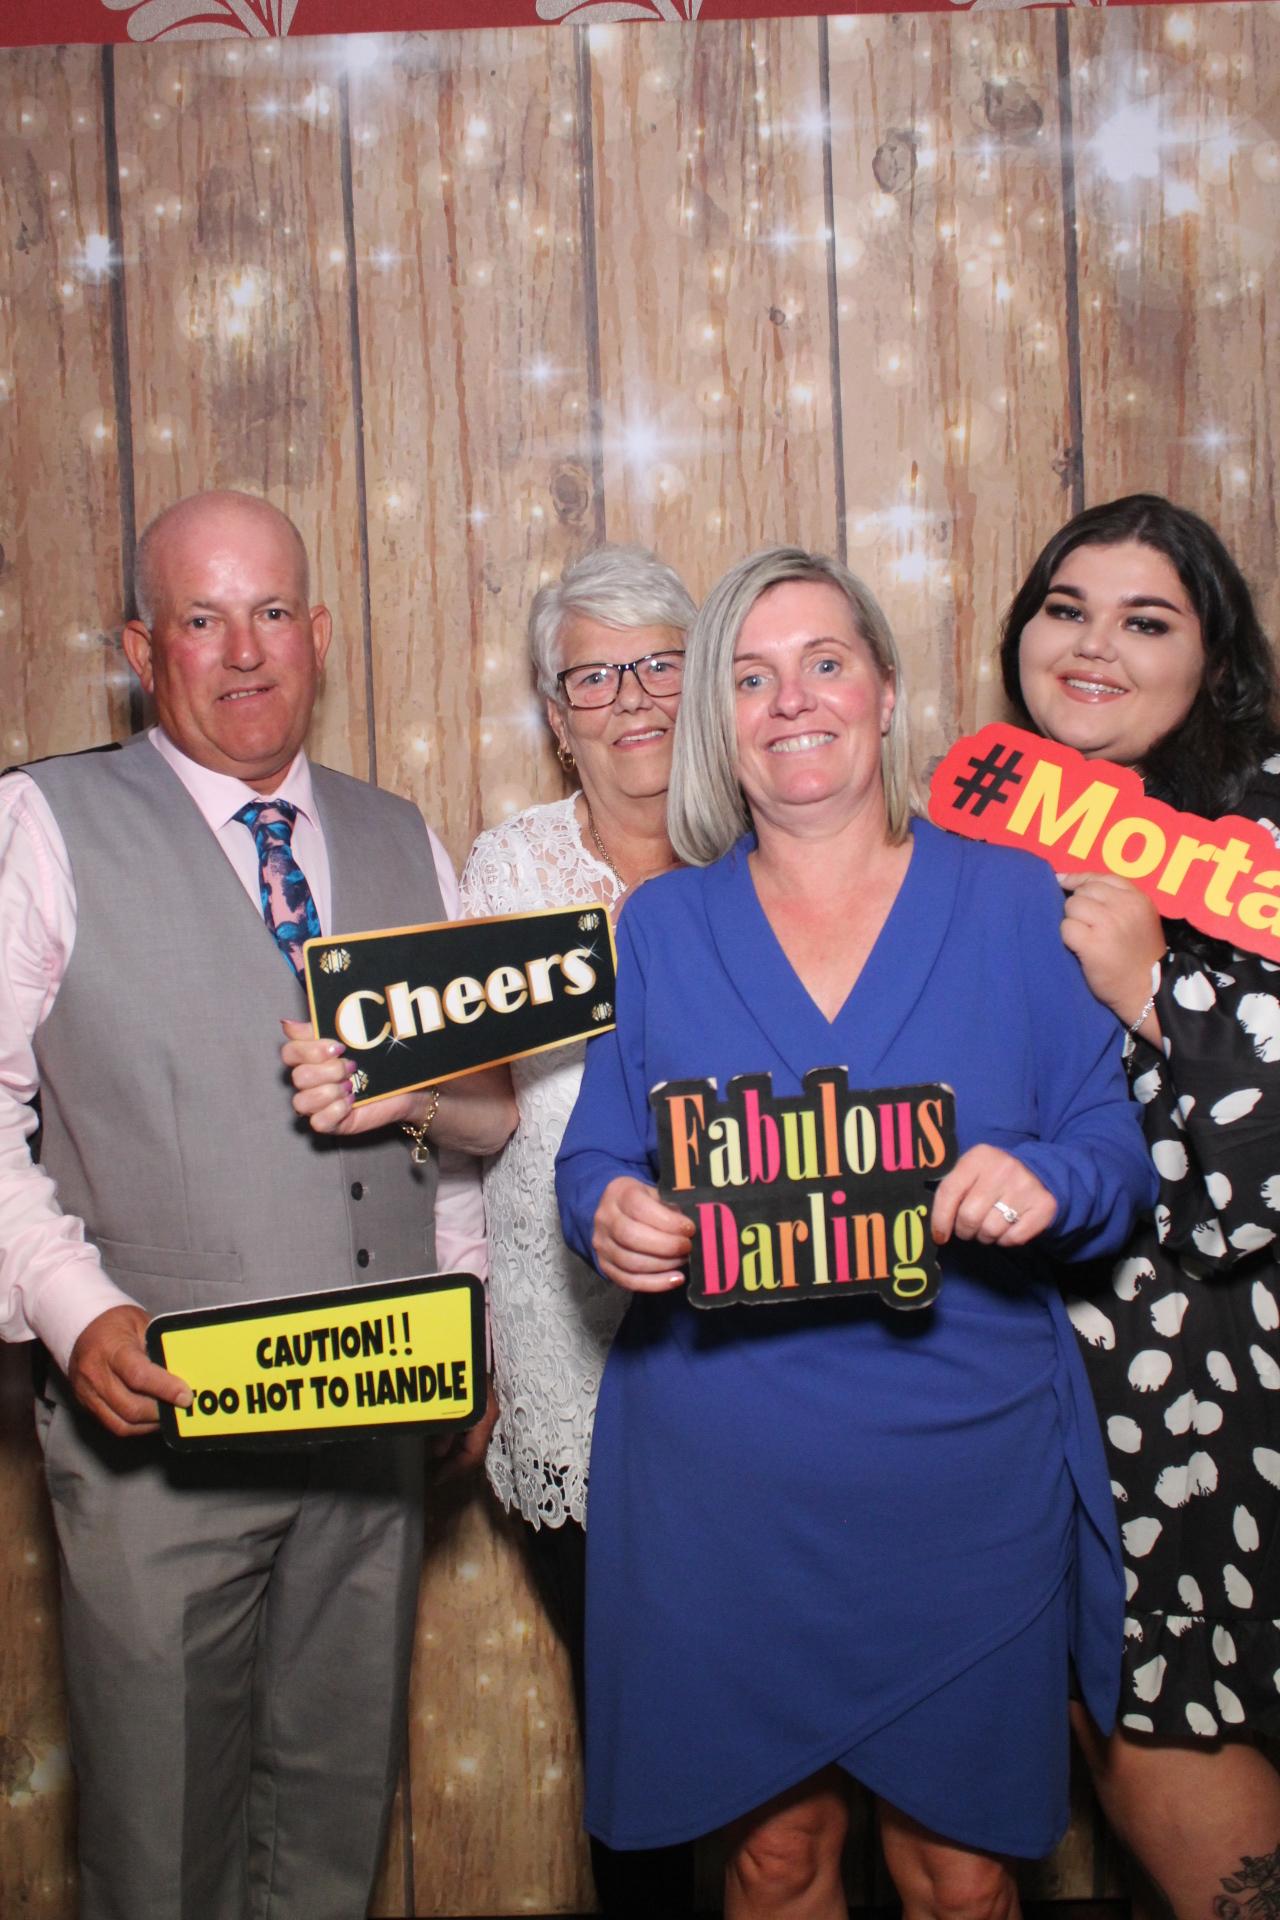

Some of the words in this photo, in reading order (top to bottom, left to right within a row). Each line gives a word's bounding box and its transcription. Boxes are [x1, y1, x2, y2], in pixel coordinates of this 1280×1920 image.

[952, 743, 1280, 937] #Morta
[335, 947, 597, 1050] Cheers
[665, 1081, 946, 1191] Fabulous
[695, 1190, 928, 1297] Darling
[245, 1376, 304, 1414] HOT
[311, 1375, 349, 1409] TO
[355, 1360, 468, 1407] HANDLE
[256, 1312, 413, 1369] CAUTION!!
